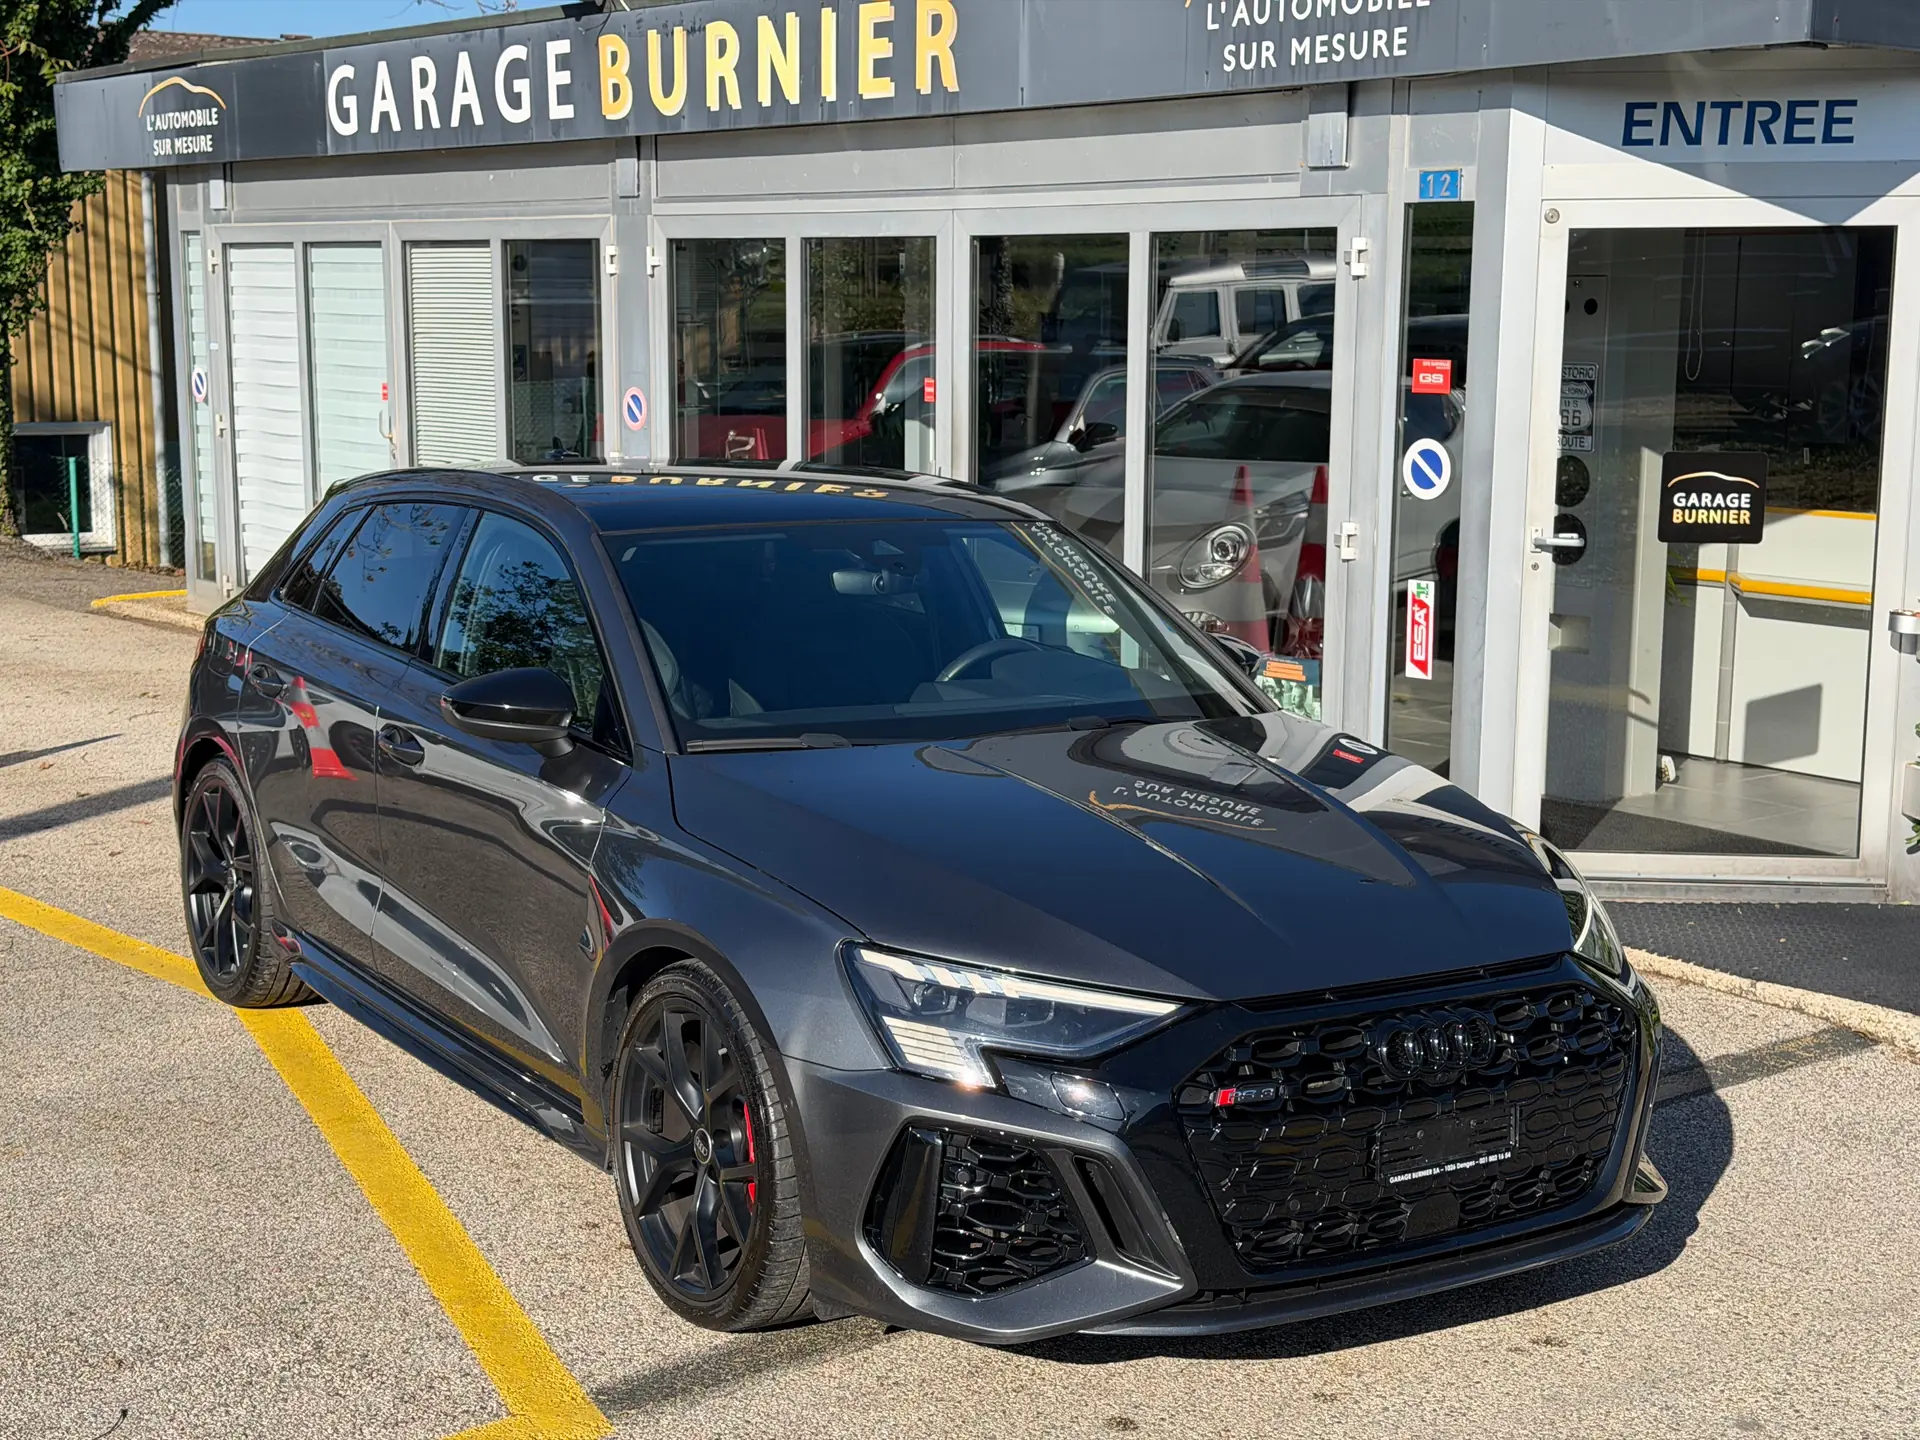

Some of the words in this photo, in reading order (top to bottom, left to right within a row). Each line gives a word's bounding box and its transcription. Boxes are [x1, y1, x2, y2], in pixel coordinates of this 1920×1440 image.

[1206, 0, 1431, 31] L'AUTOMO
[1223, 40, 1277, 72] SUR
[1291, 26, 1408, 66] MESURE
[327, 38, 575, 137] GARAGE
[598, 0, 960, 120] BURNIER
[146, 107, 219, 132] L'AUTOMOBILE
[1621, 99, 1858, 146] ENTREE
[153, 139, 173, 156] SUR
[174, 134, 214, 155] MESURE
[1426, 173, 1452, 198] 12
[1419, 372, 1444, 384] GS
[1562, 366, 1594, 379] STORIC
[1560, 409, 1581, 426] 66
[1673, 492, 1751, 508] GARAGE
[1672, 508, 1751, 525] BURNIER
[1389, 1173, 1412, 1184] GARAGE
[1412, 1169, 1433, 1179] BURNIER
[1433, 1167, 1441, 1175] SA
